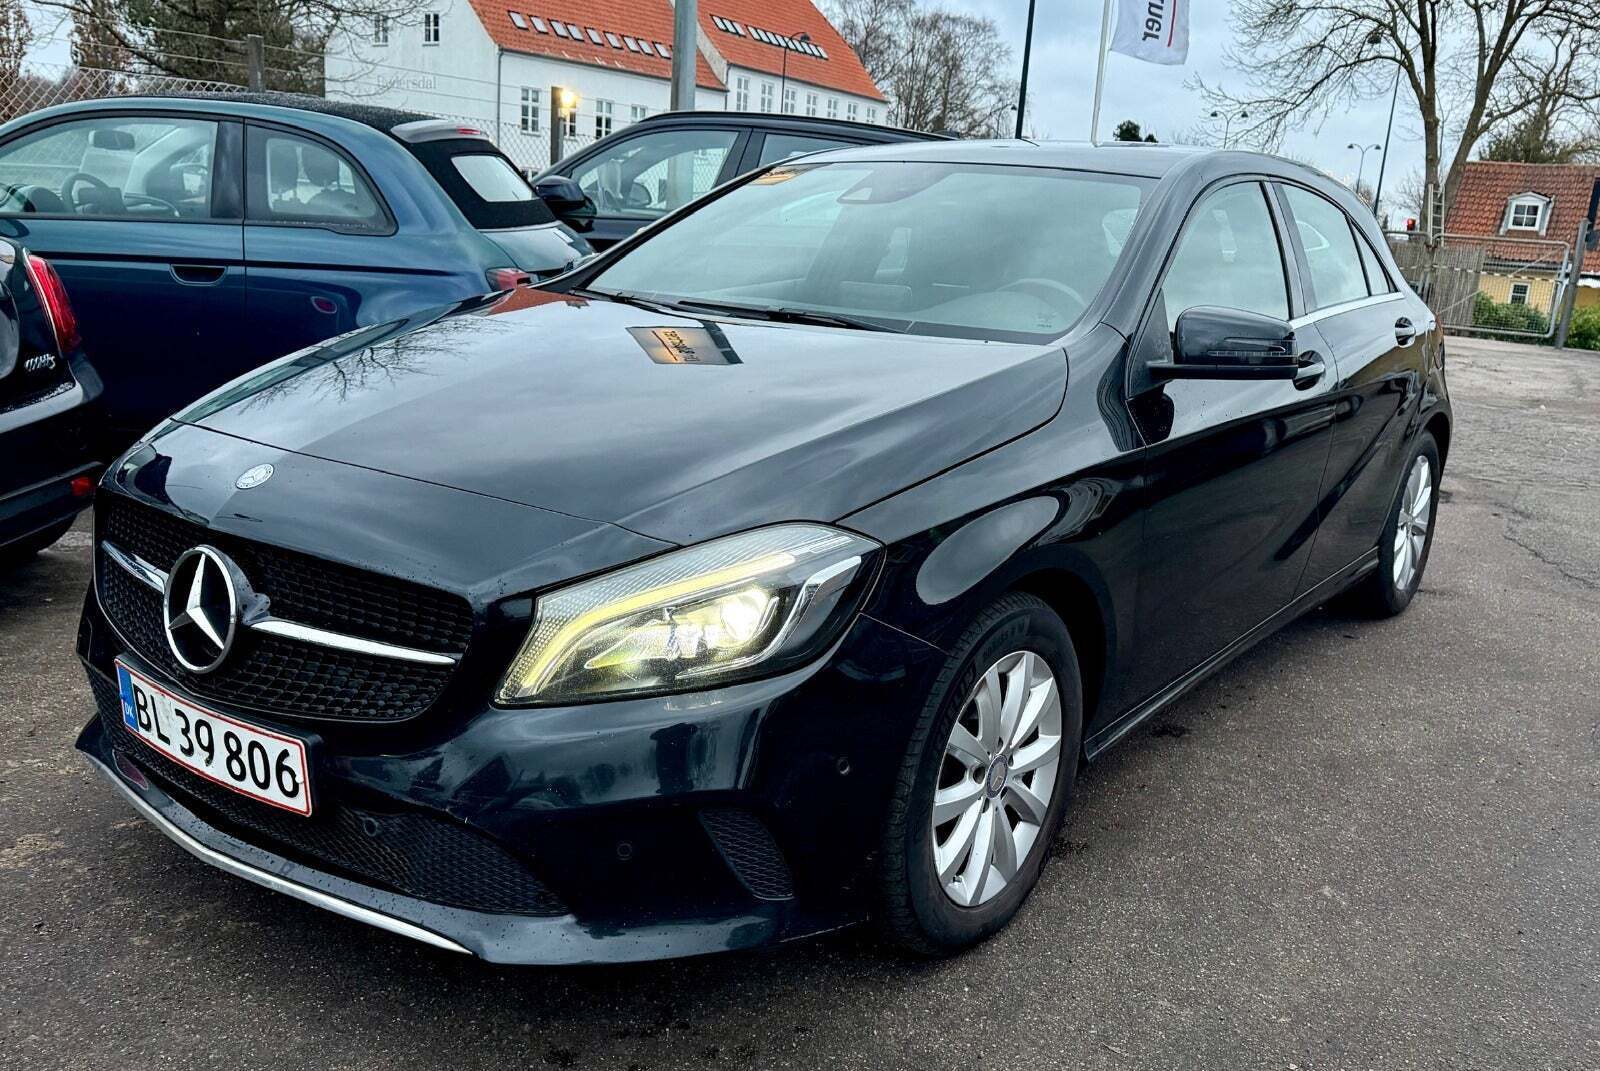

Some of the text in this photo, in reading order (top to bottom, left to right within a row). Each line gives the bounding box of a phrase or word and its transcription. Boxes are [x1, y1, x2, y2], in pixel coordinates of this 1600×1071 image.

[124, 702, 135, 718] DK
[133, 683, 300, 798] BL 39 806
